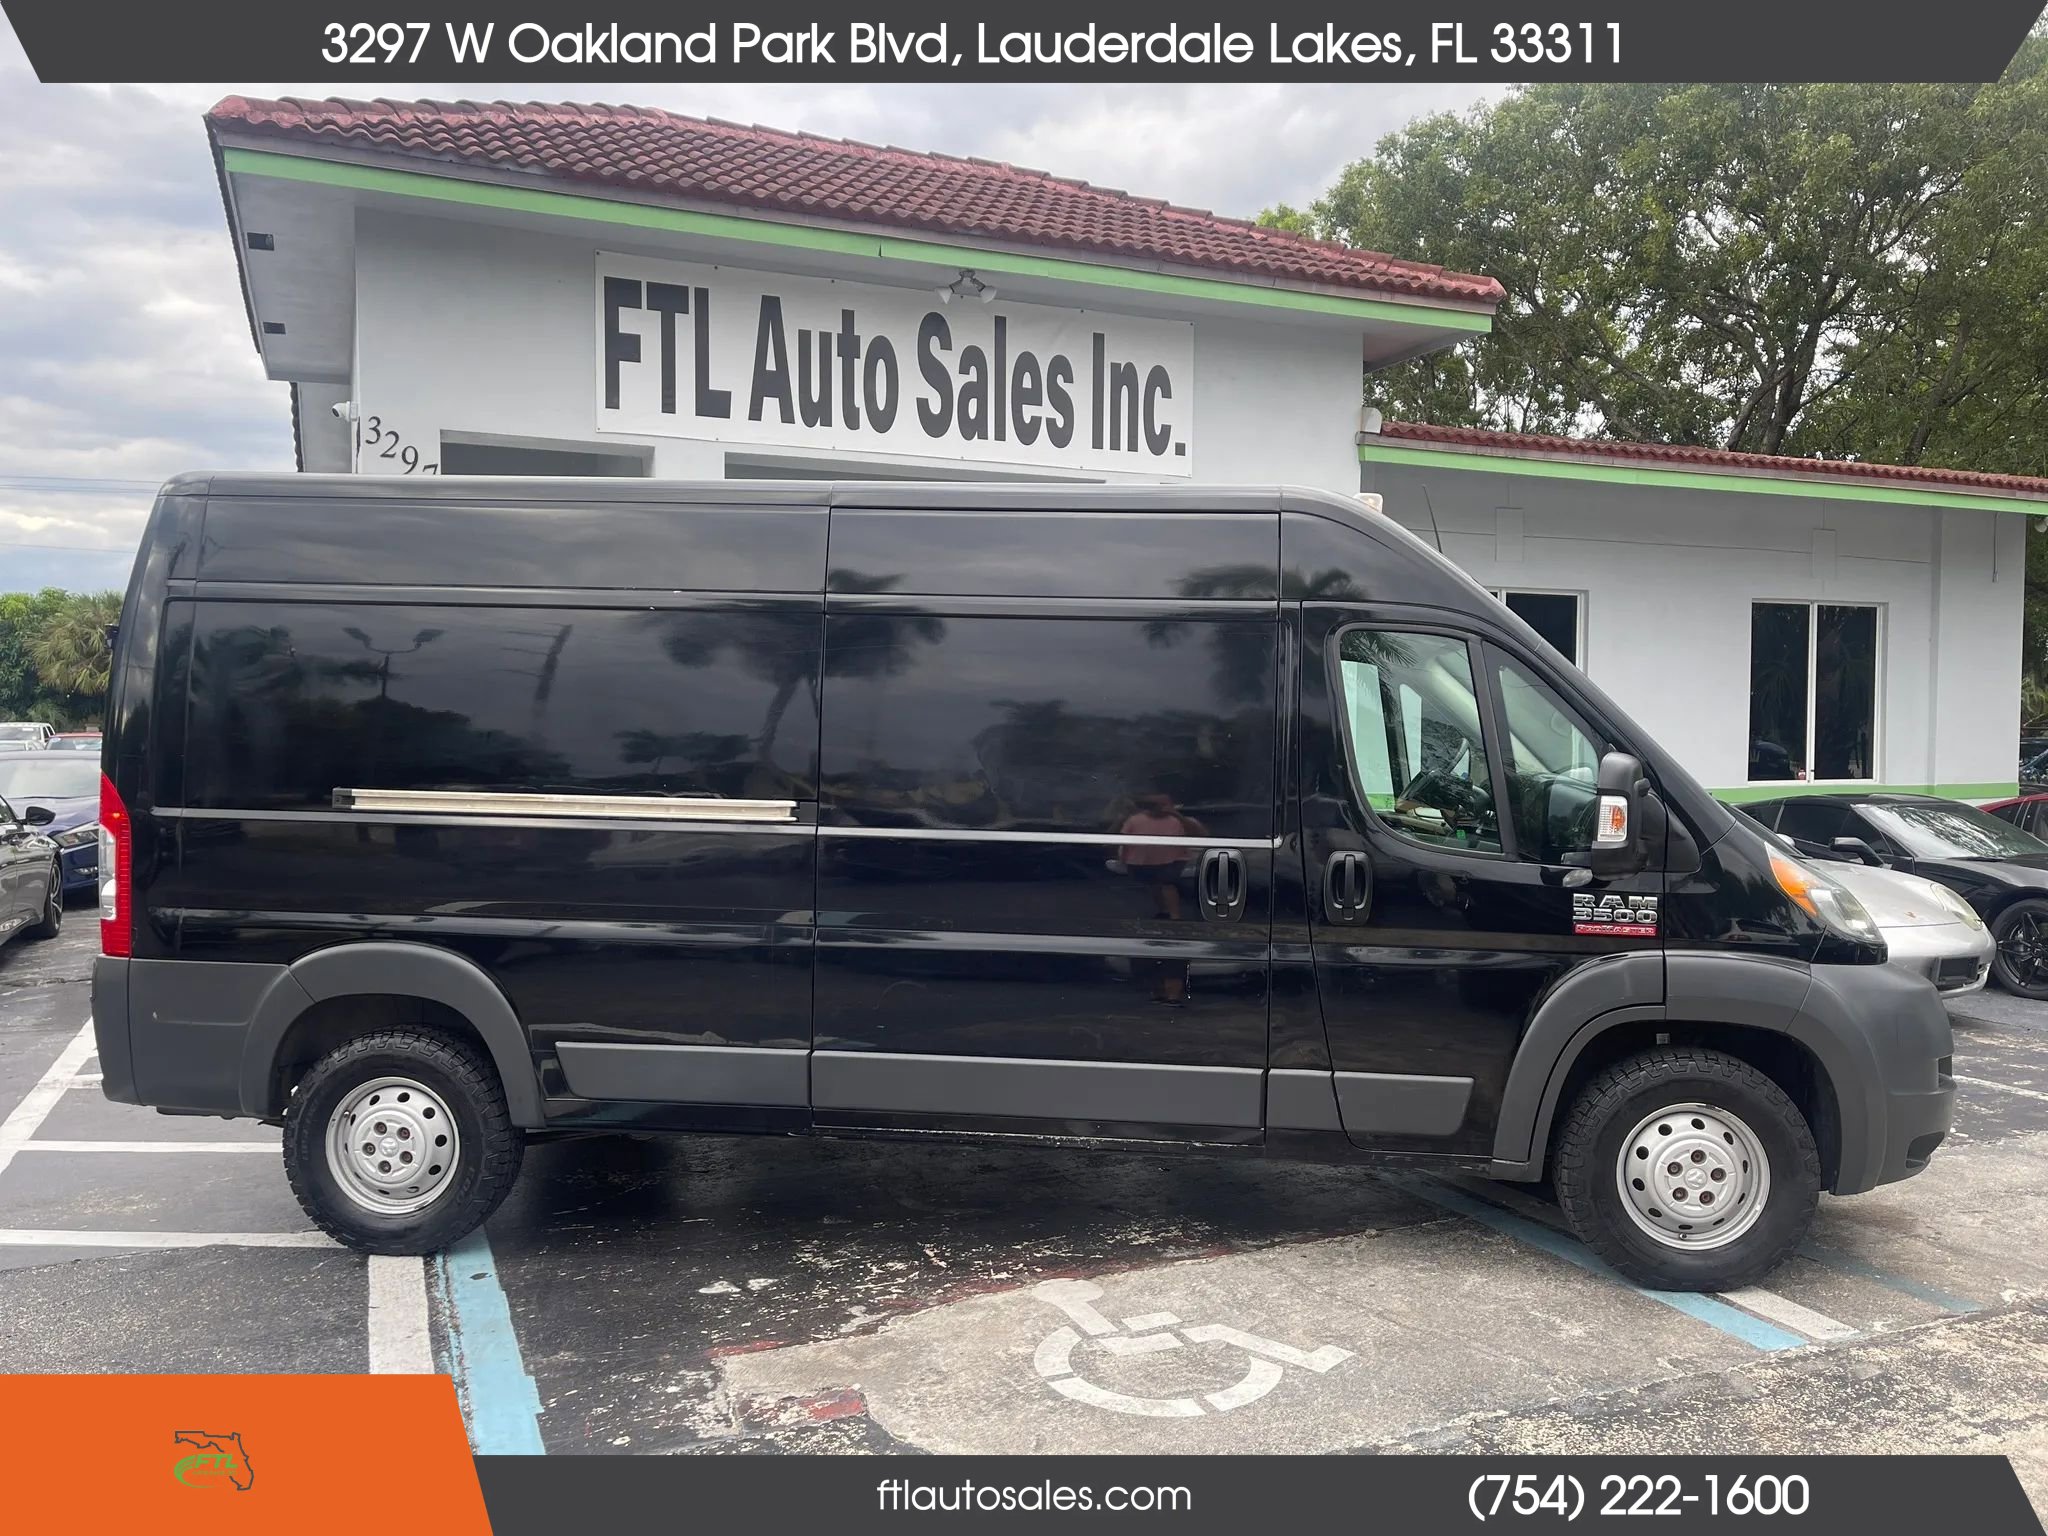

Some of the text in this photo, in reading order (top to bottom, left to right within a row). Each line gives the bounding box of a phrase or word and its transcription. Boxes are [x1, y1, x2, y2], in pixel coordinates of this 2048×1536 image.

[603, 276, 1187, 457] FTL Auto Sales Inc.
[1572, 893, 1658, 910] RAM
[1572, 907, 1658, 923] 3500
